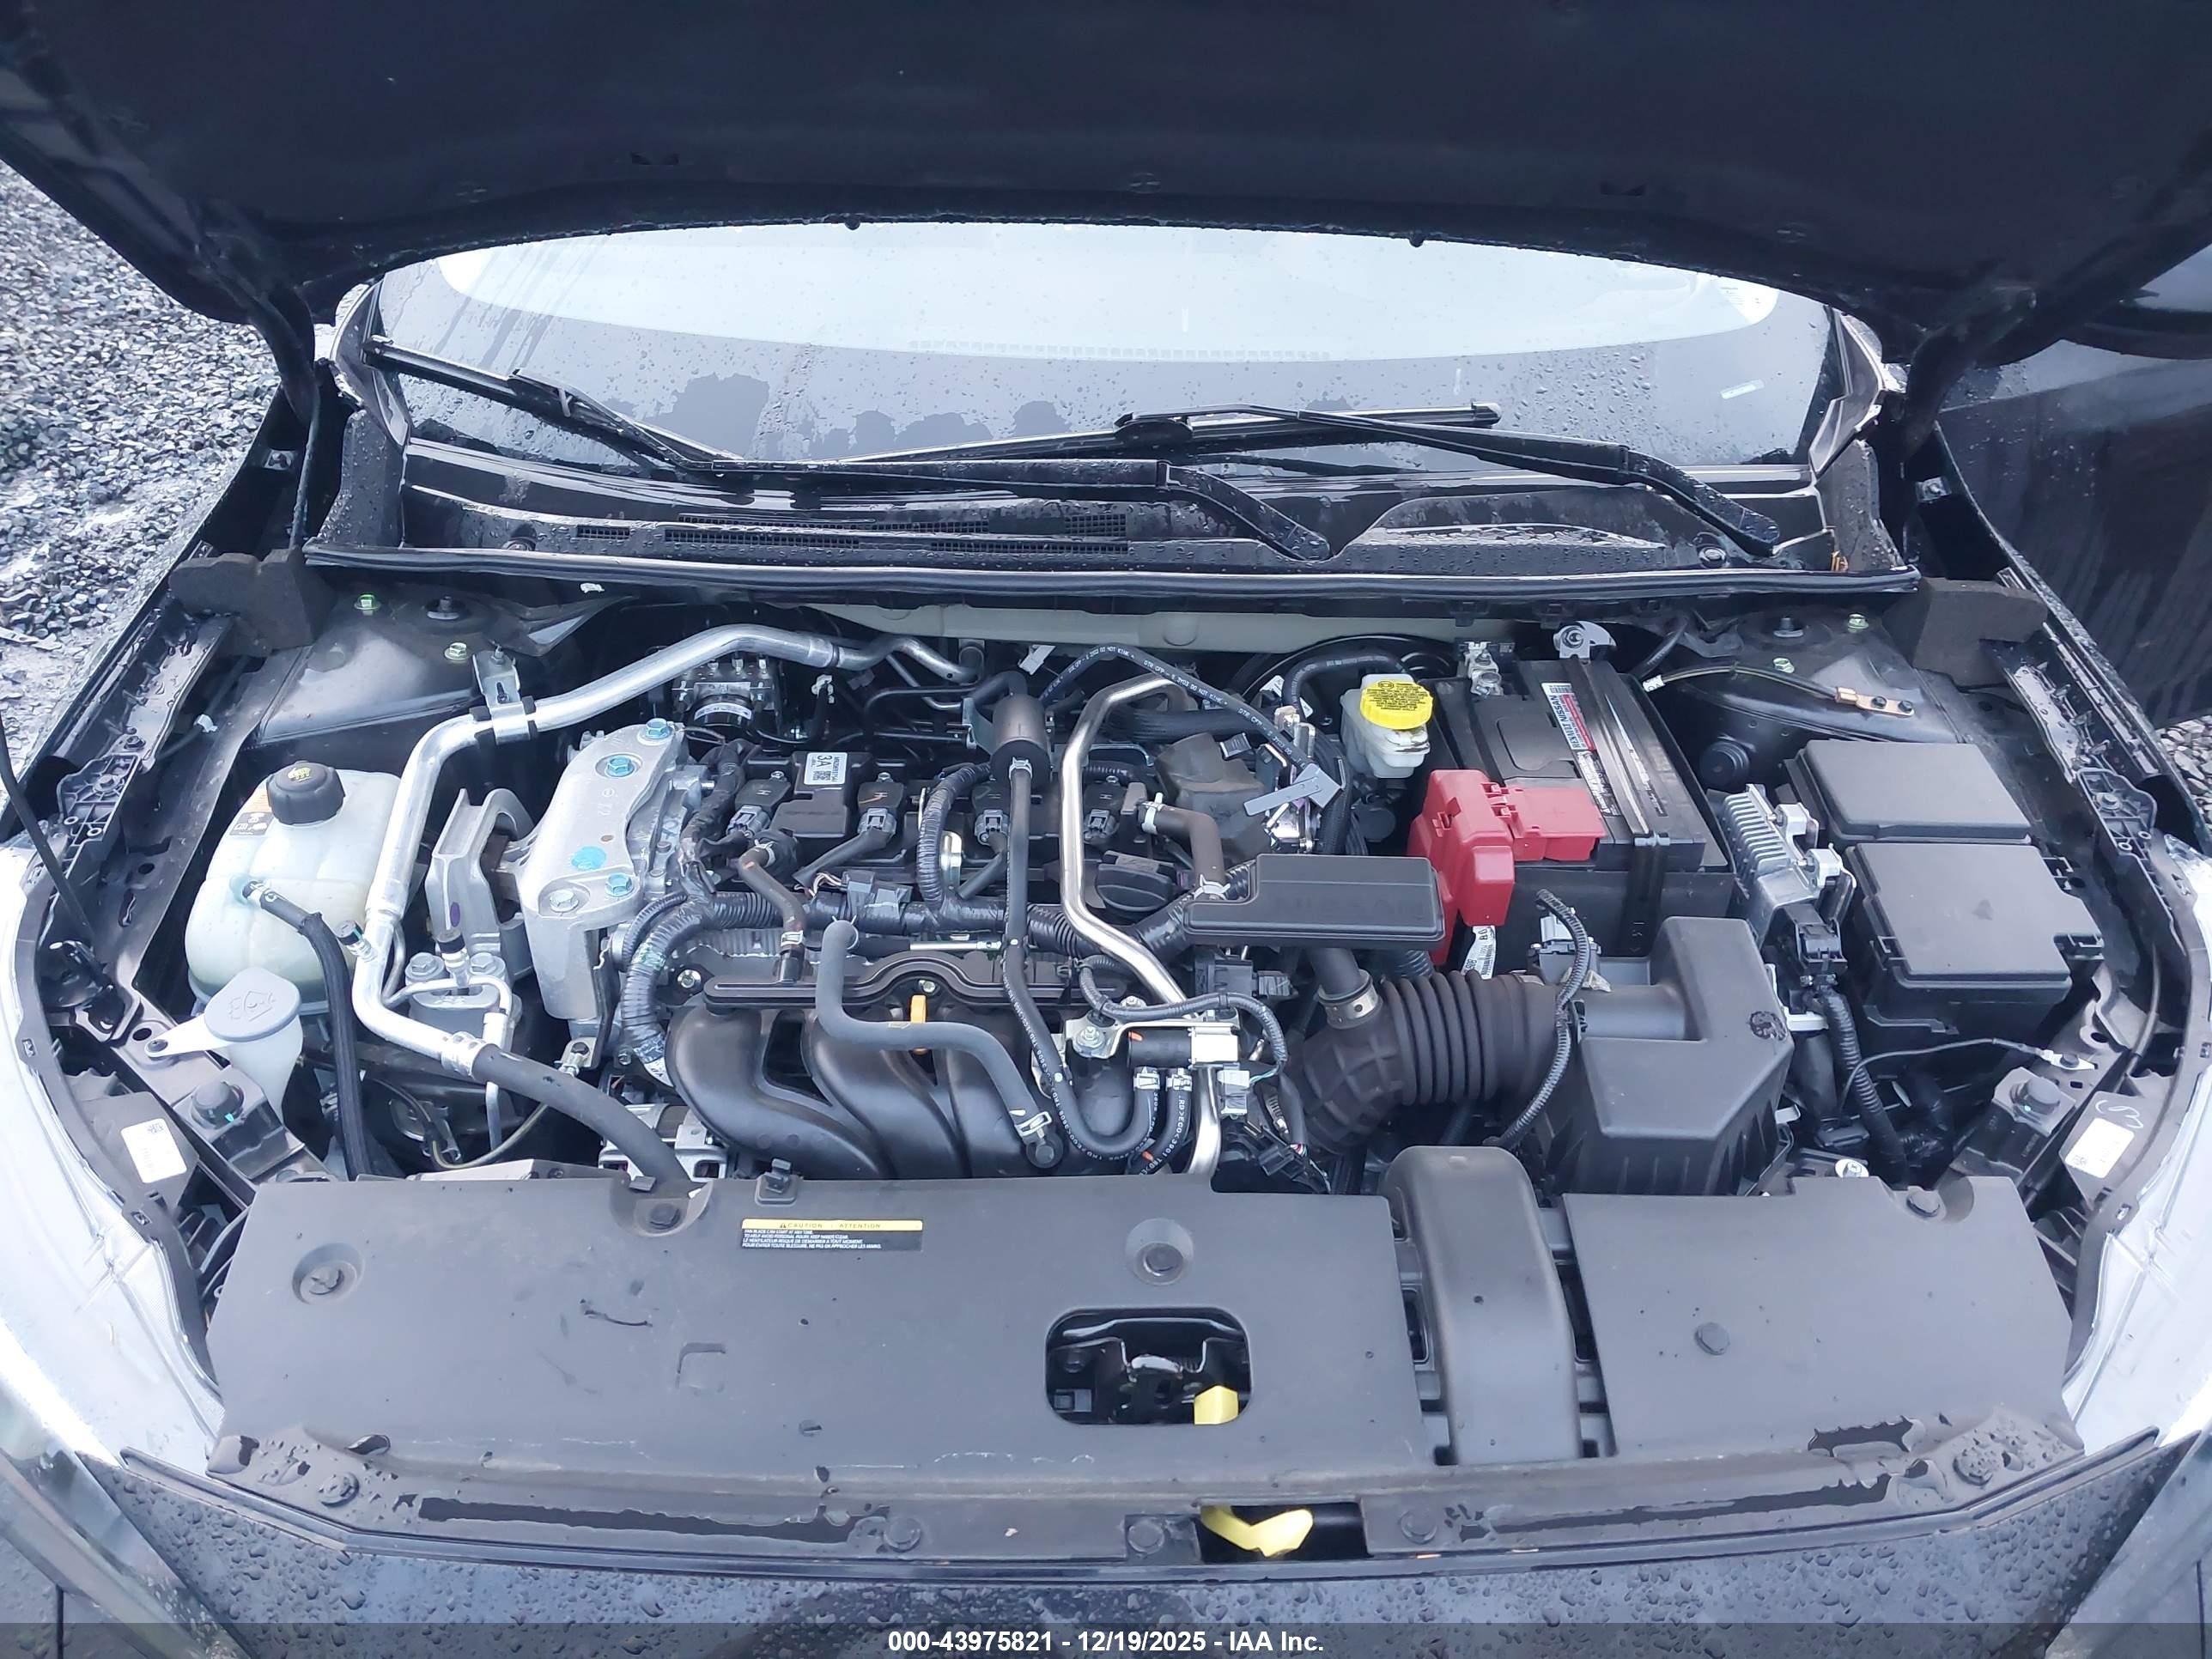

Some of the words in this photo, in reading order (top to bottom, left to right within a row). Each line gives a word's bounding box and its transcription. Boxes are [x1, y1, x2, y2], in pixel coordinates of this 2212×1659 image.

[1549, 695, 1569, 722] NISSAN
[1562, 723, 1581, 748] RENAULT
[817, 755, 833, 768] 3A
